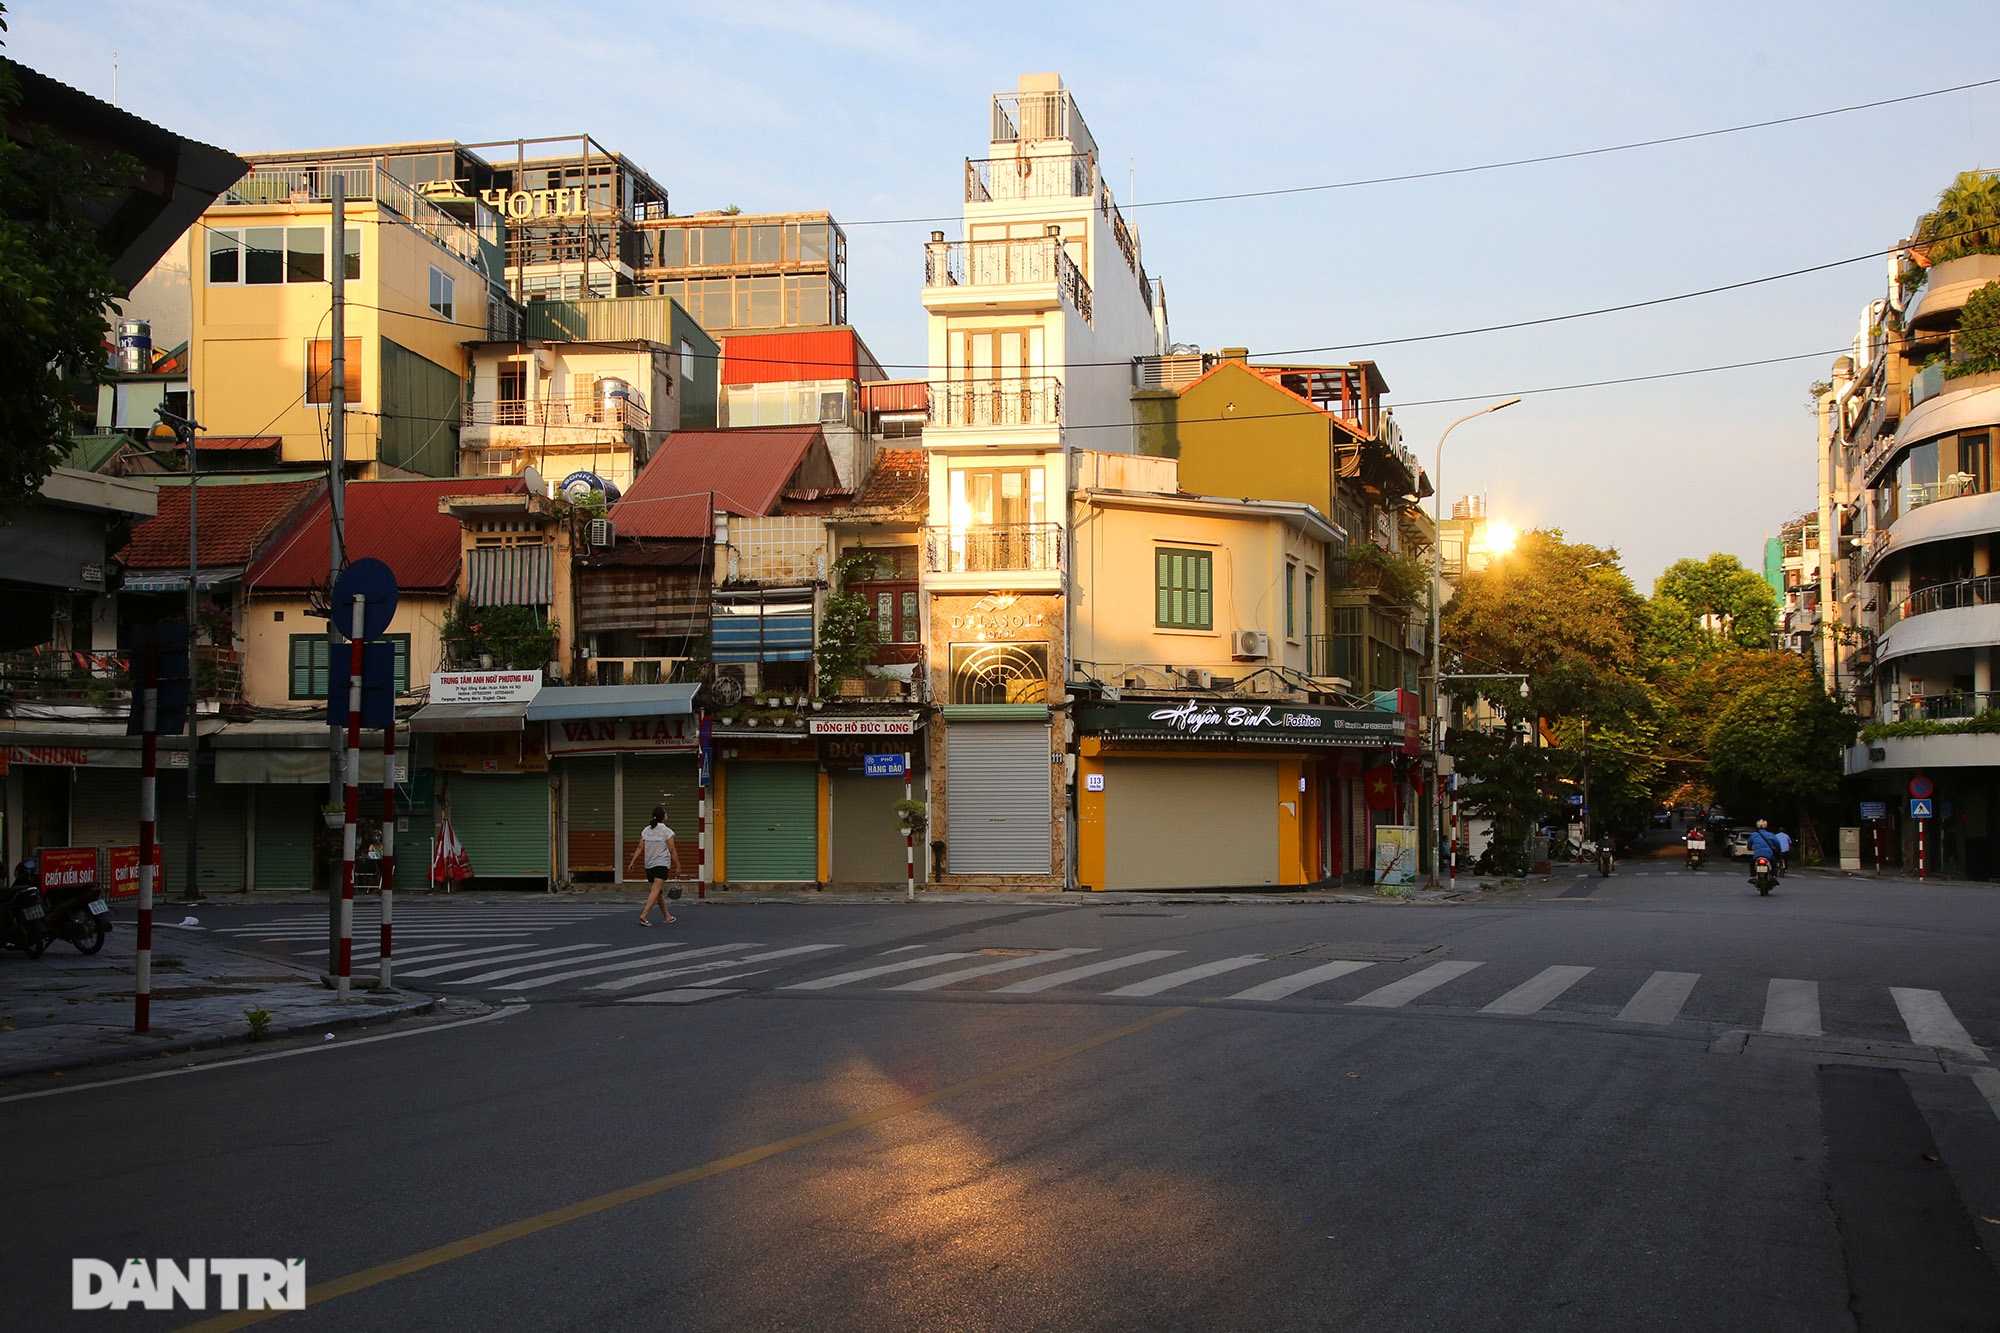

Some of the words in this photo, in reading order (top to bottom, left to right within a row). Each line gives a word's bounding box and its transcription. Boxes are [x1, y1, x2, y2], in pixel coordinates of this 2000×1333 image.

[480, 188, 589, 219] HOTEL
[441, 676, 458, 685] TRUNG
[460, 675, 471, 684] TÂM
[522, 674, 534, 682] MAI
[1148, 699, 1223, 734] Huyền
[1225, 705, 1282, 727] Bình
[1285, 713, 1321, 727] Fashion
[561, 718, 616, 741] VÂN
[628, 715, 685, 740] HẢI
[816, 721, 842, 732] ĐỒNG
[844, 721, 858, 732] HỒ
[860, 721, 881, 732] ĐỨC
[884, 723, 909, 732] LONG
[1052, 753, 1062, 762] 111
[868, 764, 887, 773] HÀNG
[889, 763, 902, 772] ĐÀO
